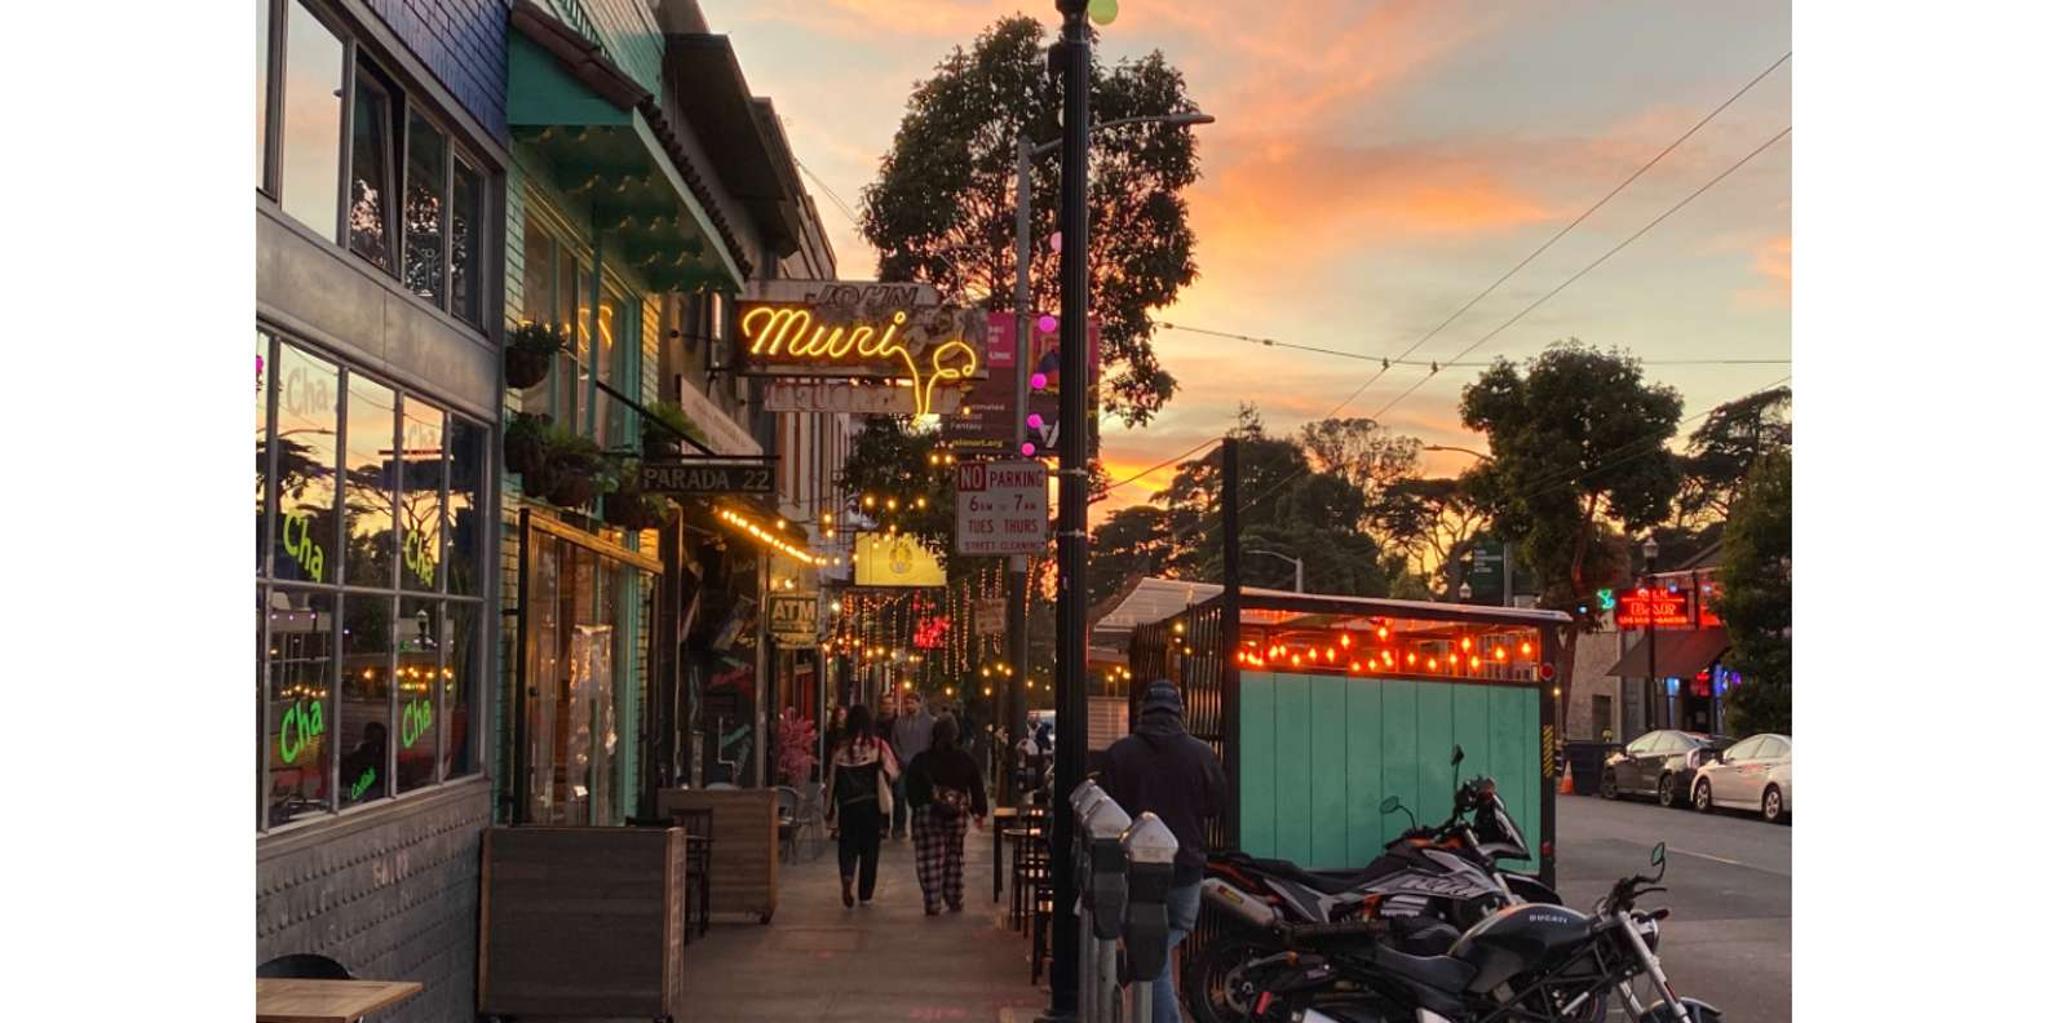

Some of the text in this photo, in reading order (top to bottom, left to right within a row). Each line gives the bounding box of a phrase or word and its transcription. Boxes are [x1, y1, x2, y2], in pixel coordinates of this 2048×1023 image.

[642, 466, 771, 490] PARADA 22
[960, 465, 1043, 490] NO PARKING
[968, 519, 1039, 533] TUES THURS
[283, 508, 324, 583] Cha
[405, 529, 433, 587] Cha
[772, 600, 816, 620] ATM
[280, 700, 324, 763] Cha
[402, 698, 431, 748] Cha
[1529, 913, 1568, 924] DUCATI
